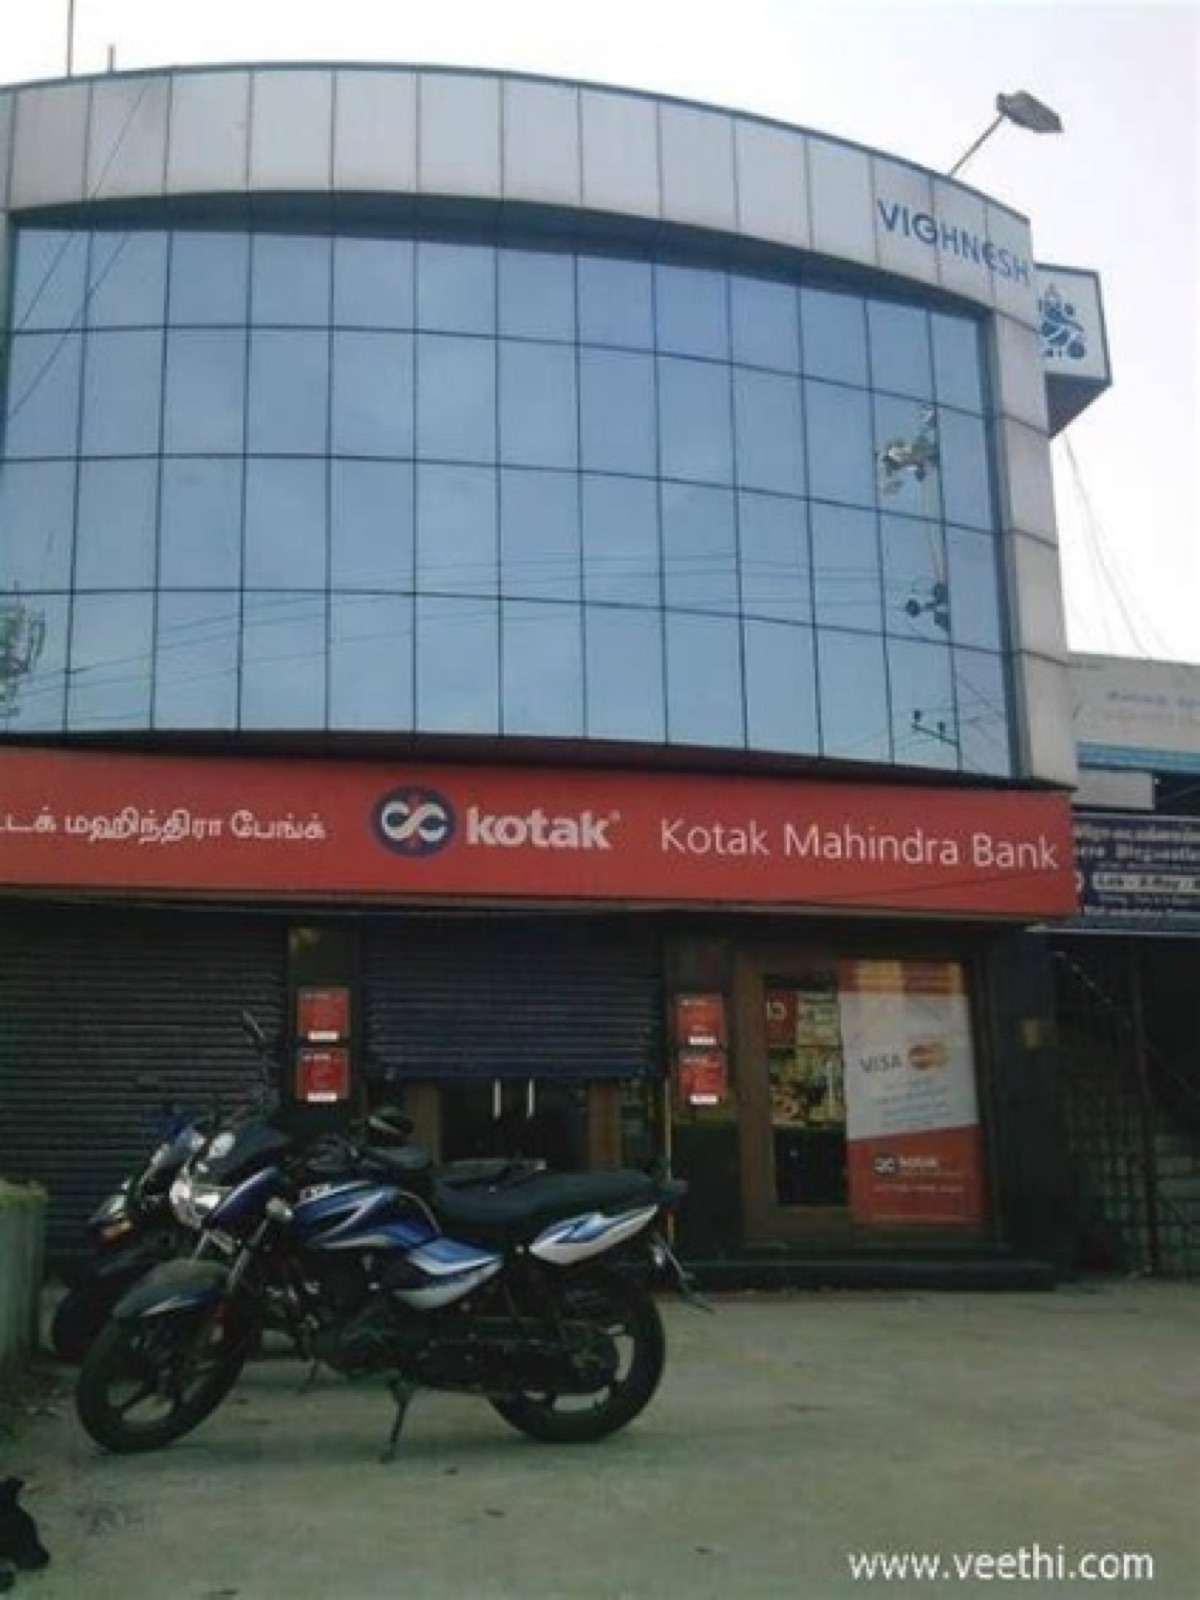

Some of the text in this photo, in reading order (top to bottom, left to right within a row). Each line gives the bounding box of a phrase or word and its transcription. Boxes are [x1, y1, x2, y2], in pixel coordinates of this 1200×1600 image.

[877, 198, 1031, 286] VIGHNESH
[64, 806, 222, 844] மஹிந்திரா
[231, 809, 326, 839] பேங்க்
[466, 804, 612, 850] kotak
[660, 819, 770, 855] Kotak
[783, 823, 958, 865] Mahindra
[972, 832, 1059, 870] Bank
